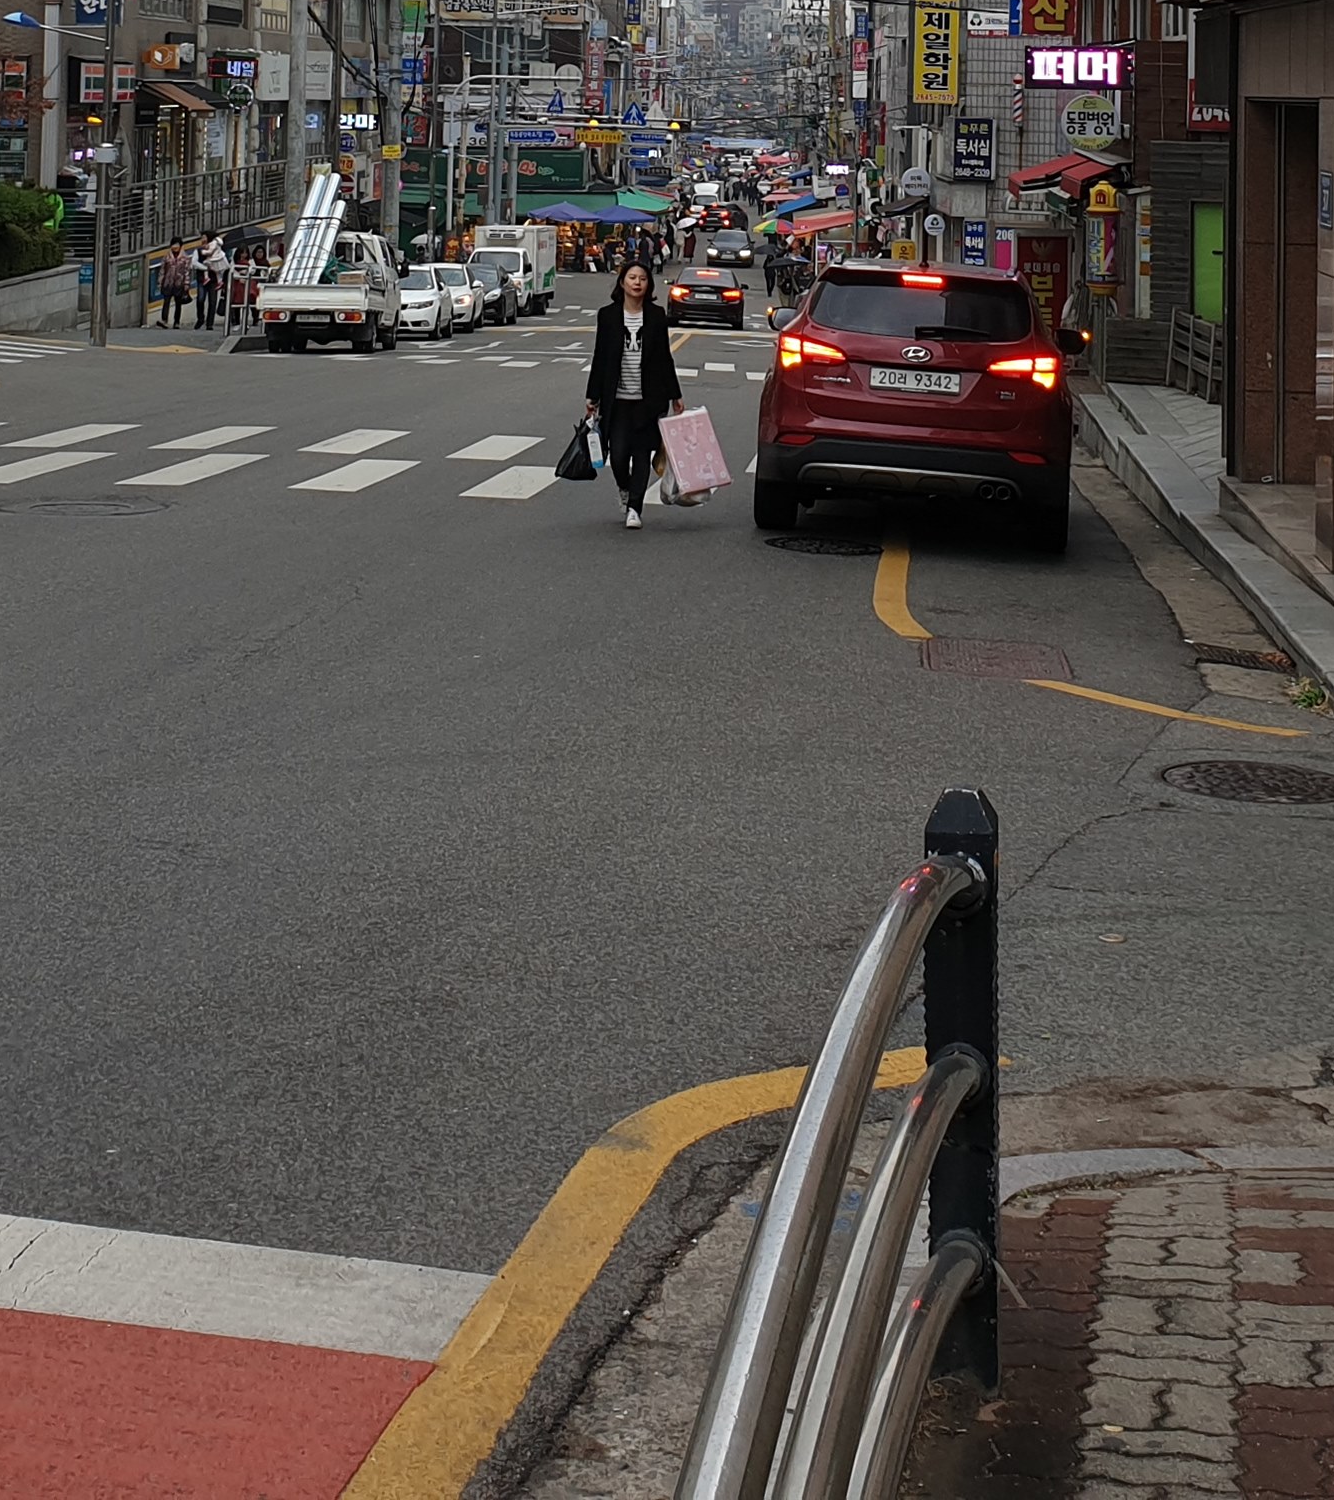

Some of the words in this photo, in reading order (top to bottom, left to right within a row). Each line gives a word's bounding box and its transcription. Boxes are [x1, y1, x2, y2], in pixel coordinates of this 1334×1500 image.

[922, 12, 952, 91] 제일학원
[226, 60, 255, 77] 네일
[959, 122, 989, 134] 늘푸른
[1066, 111, 1115, 136] 동물병원
[956, 139, 990, 156] 독서실
[914, 372, 953, 389] 9342
